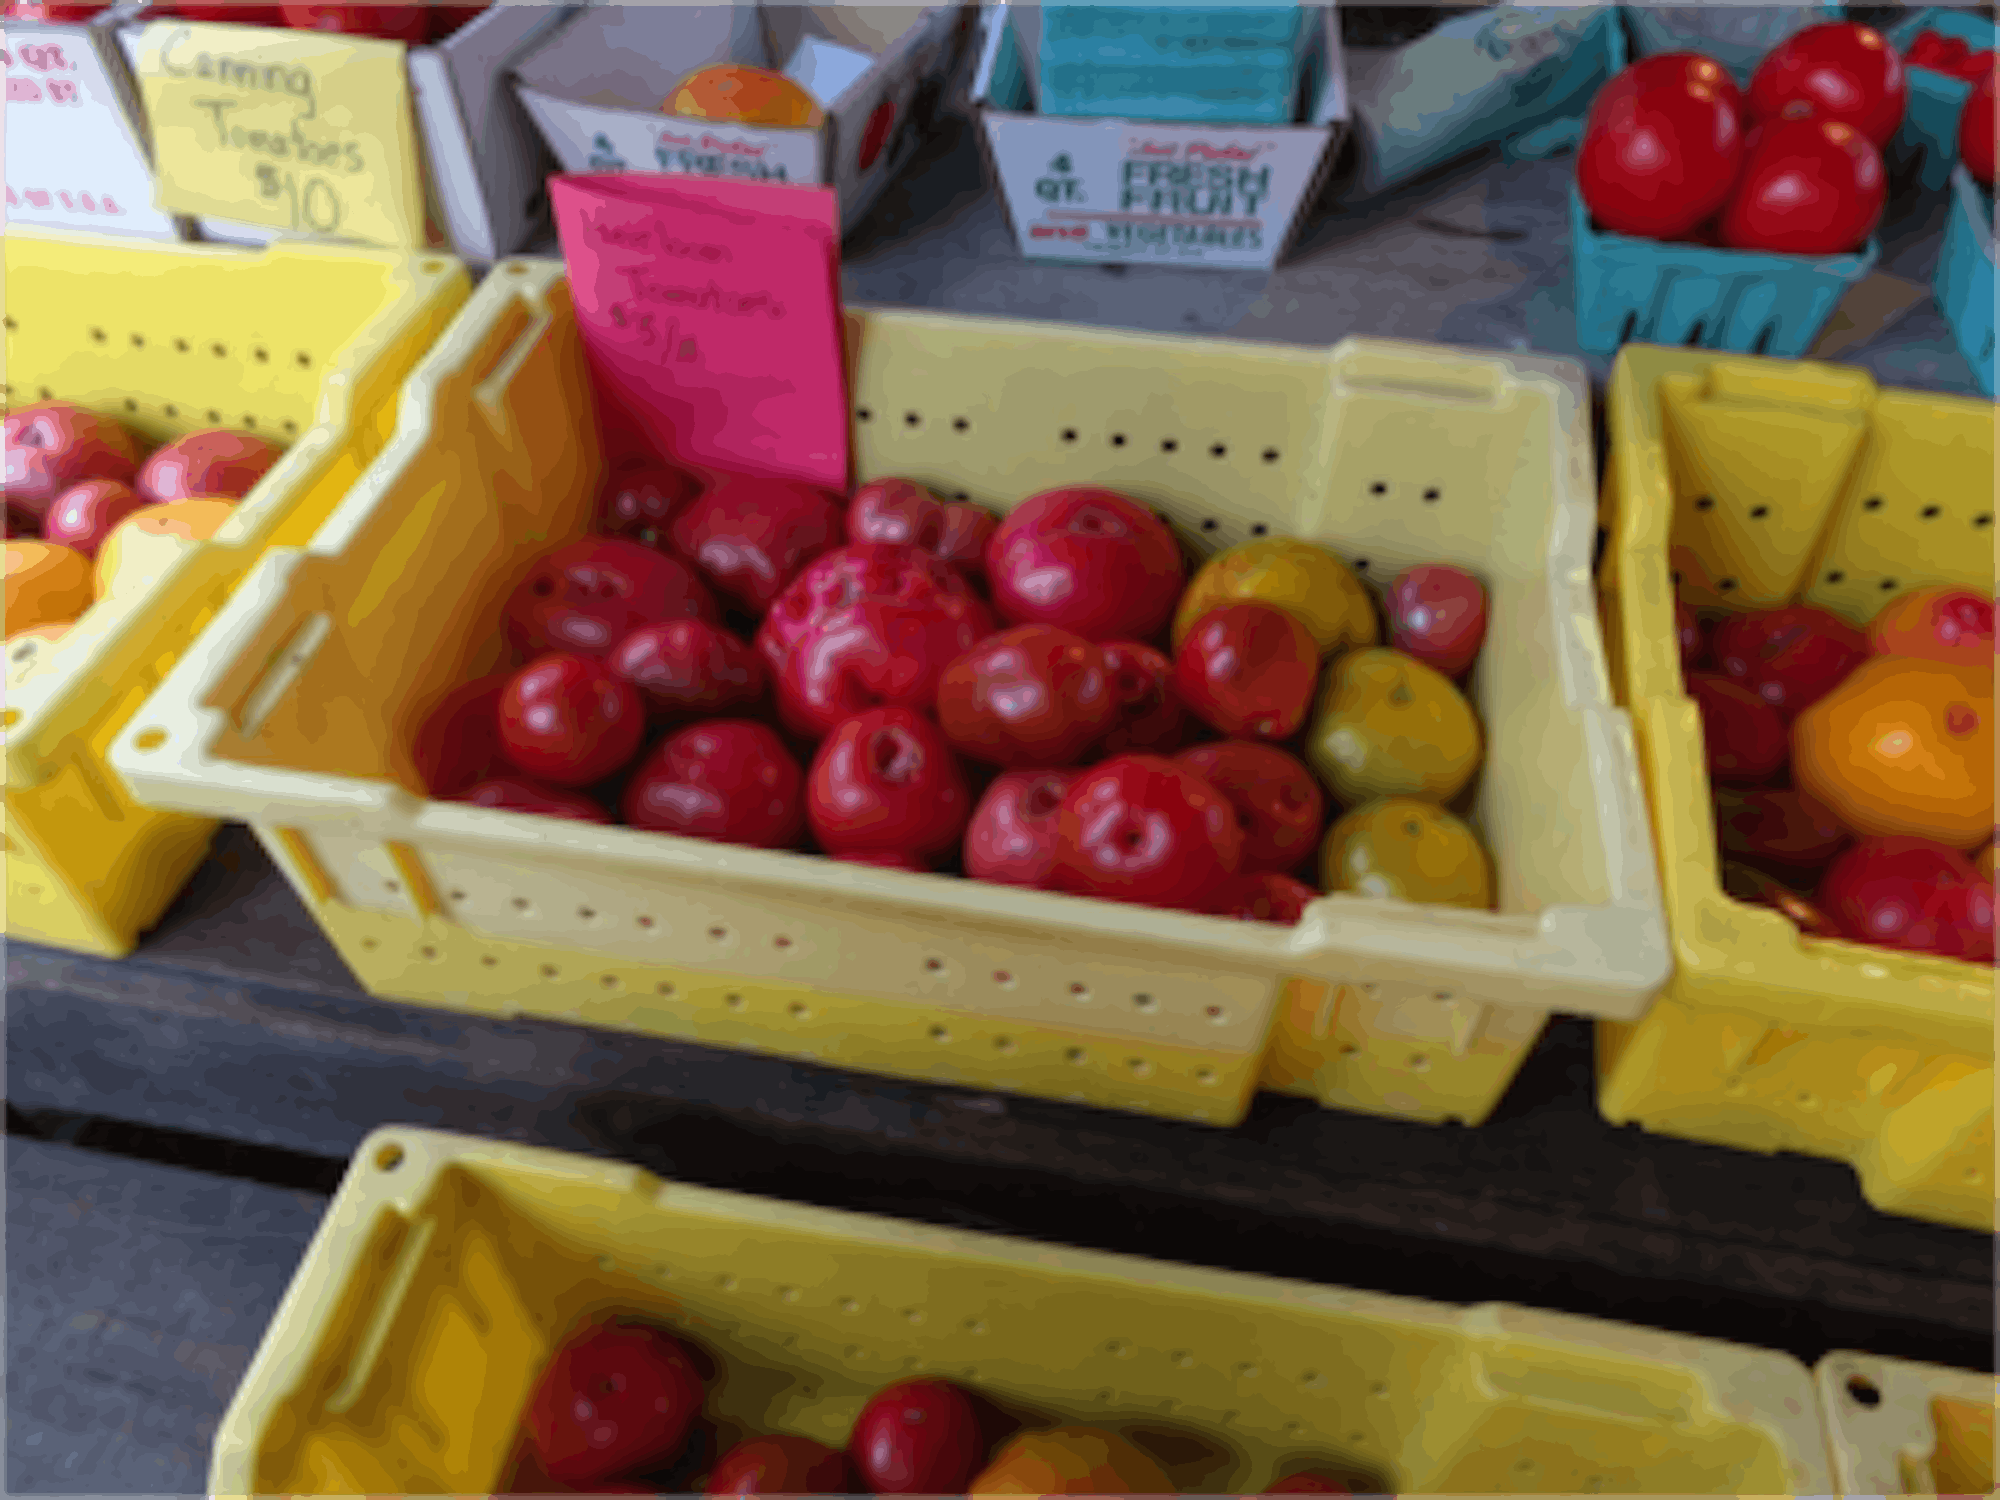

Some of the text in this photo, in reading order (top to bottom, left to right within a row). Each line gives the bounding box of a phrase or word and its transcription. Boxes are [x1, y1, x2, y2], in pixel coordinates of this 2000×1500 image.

[1049, 151, 1074, 174] 4
[1119, 158, 1272, 191] FRESH
[255, 163, 341, 233] $10
[1119, 185, 1261, 216] FRUIT
